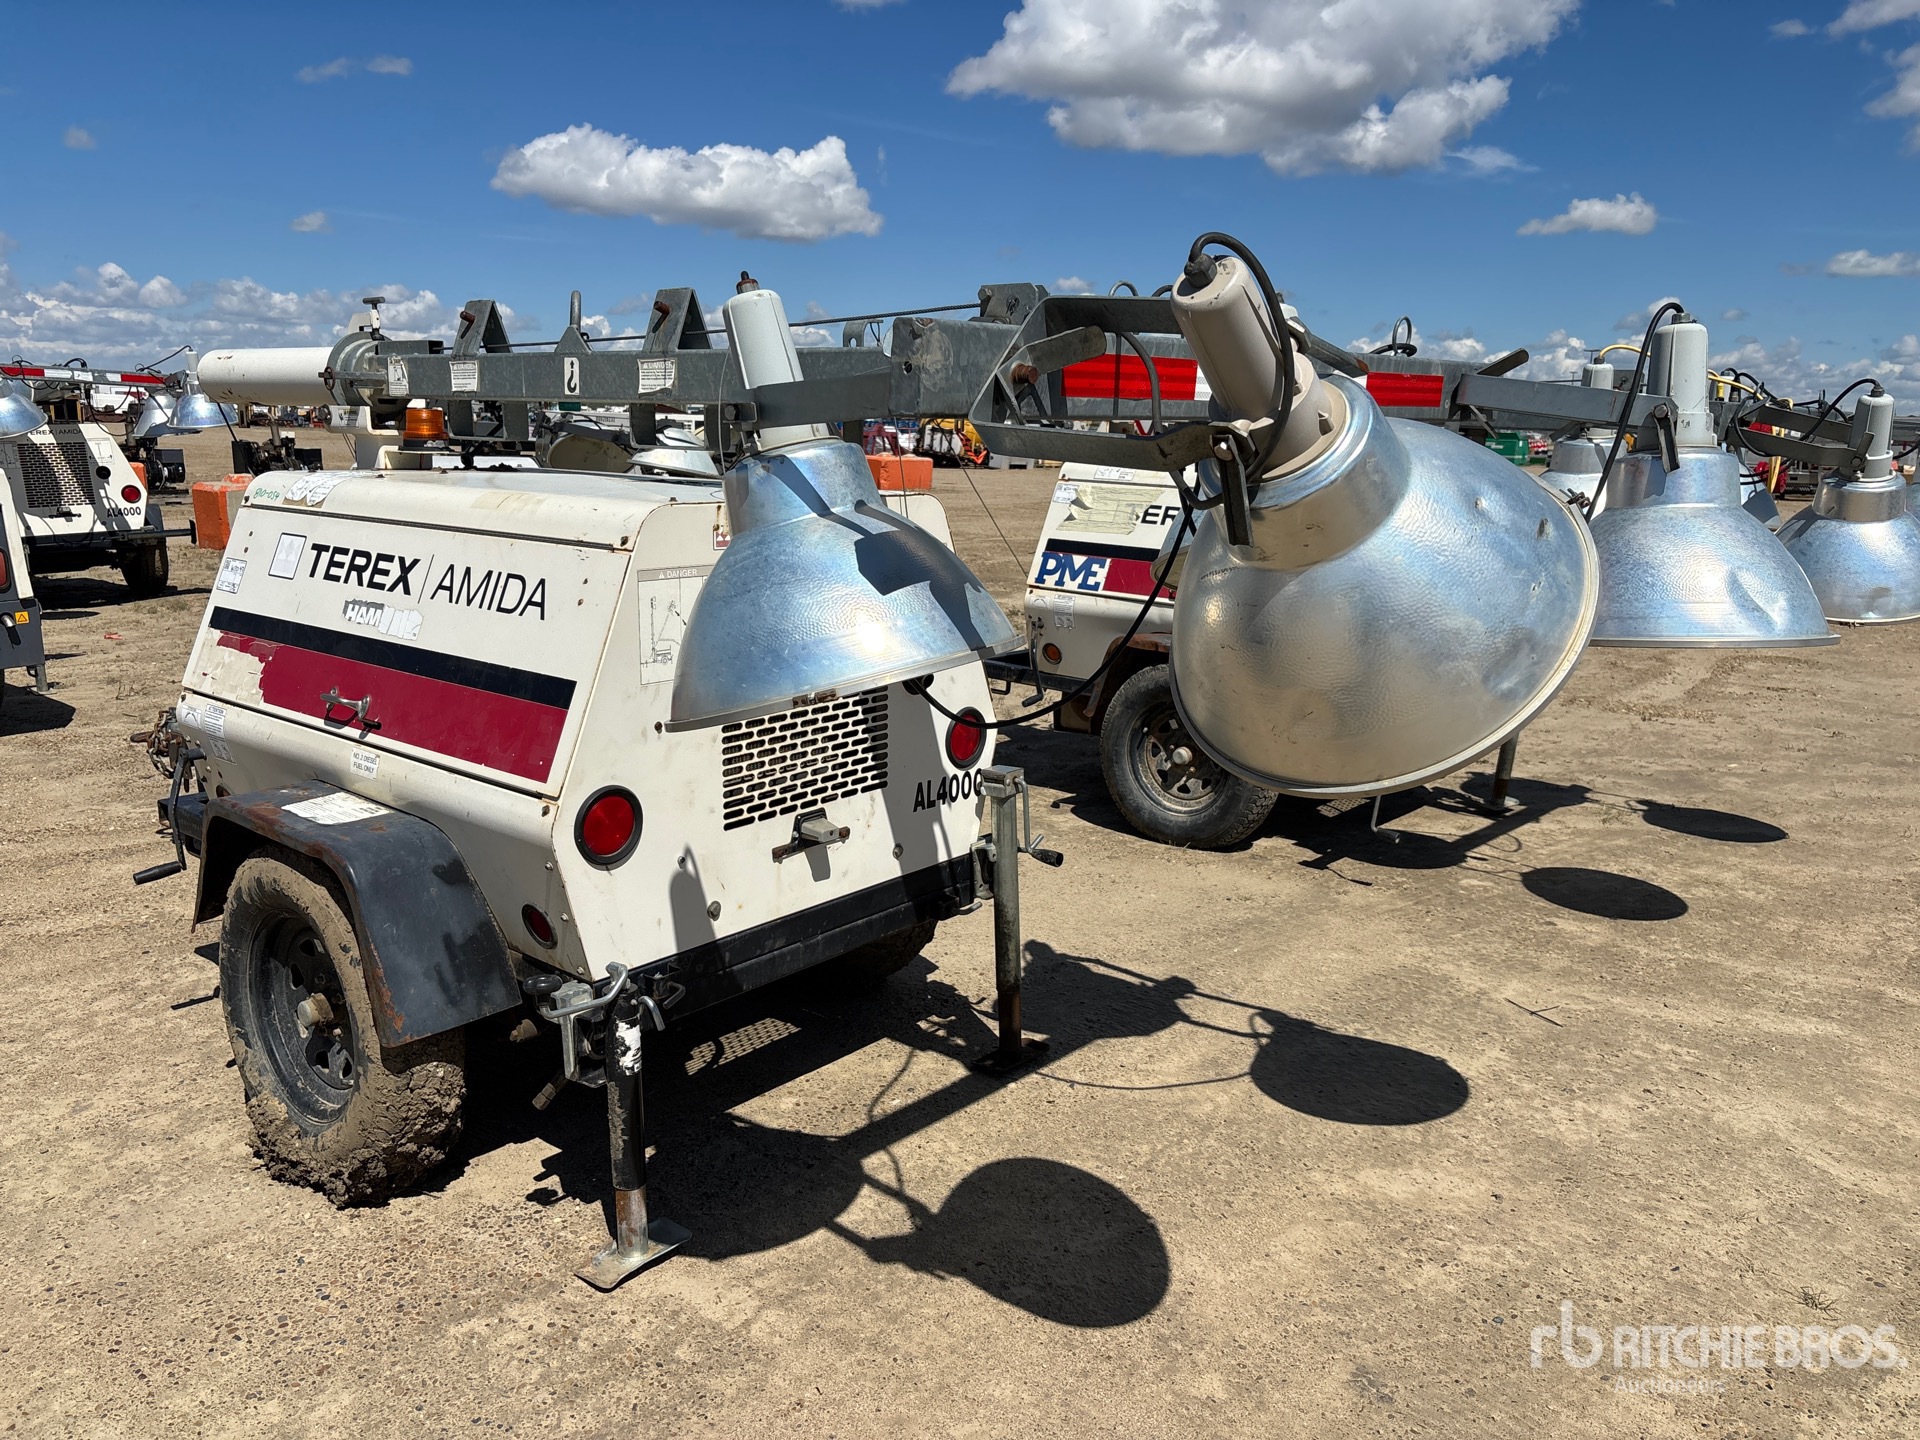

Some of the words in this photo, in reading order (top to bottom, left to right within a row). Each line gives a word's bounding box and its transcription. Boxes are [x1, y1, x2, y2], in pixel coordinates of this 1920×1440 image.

[107, 506, 142, 518] AL4000
[666, 568, 698, 578] DANGER
[1034, 550, 1108, 592] PME
[308, 542, 421, 597] TEREX
[429, 563, 547, 621] AMIDA
[363, 755, 377, 765] DIESEL
[353, 761, 363, 771] FUEL
[364, 764, 375, 773] ONLY
